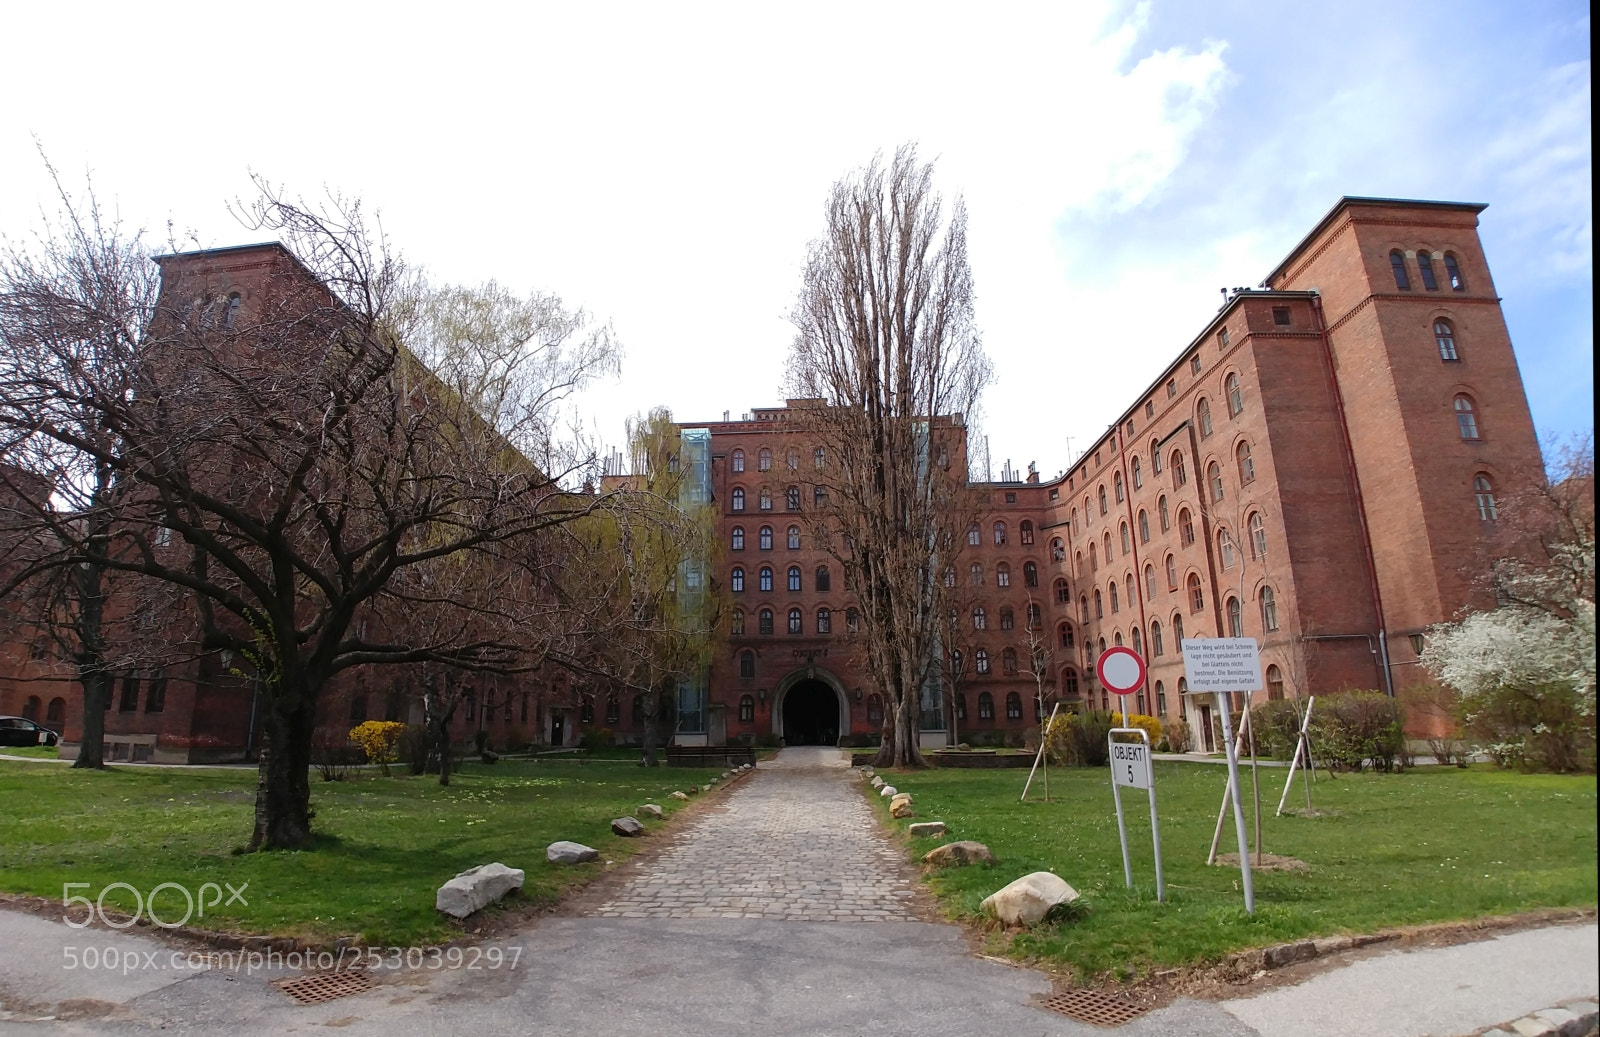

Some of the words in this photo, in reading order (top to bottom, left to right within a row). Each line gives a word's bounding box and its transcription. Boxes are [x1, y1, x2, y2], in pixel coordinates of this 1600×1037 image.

[1193, 678, 1211, 686] erfolgt
[1221, 678, 1238, 686] eigene
[1114, 745, 1142, 761] OBJEKT
[1127, 764, 1134, 783] 5
